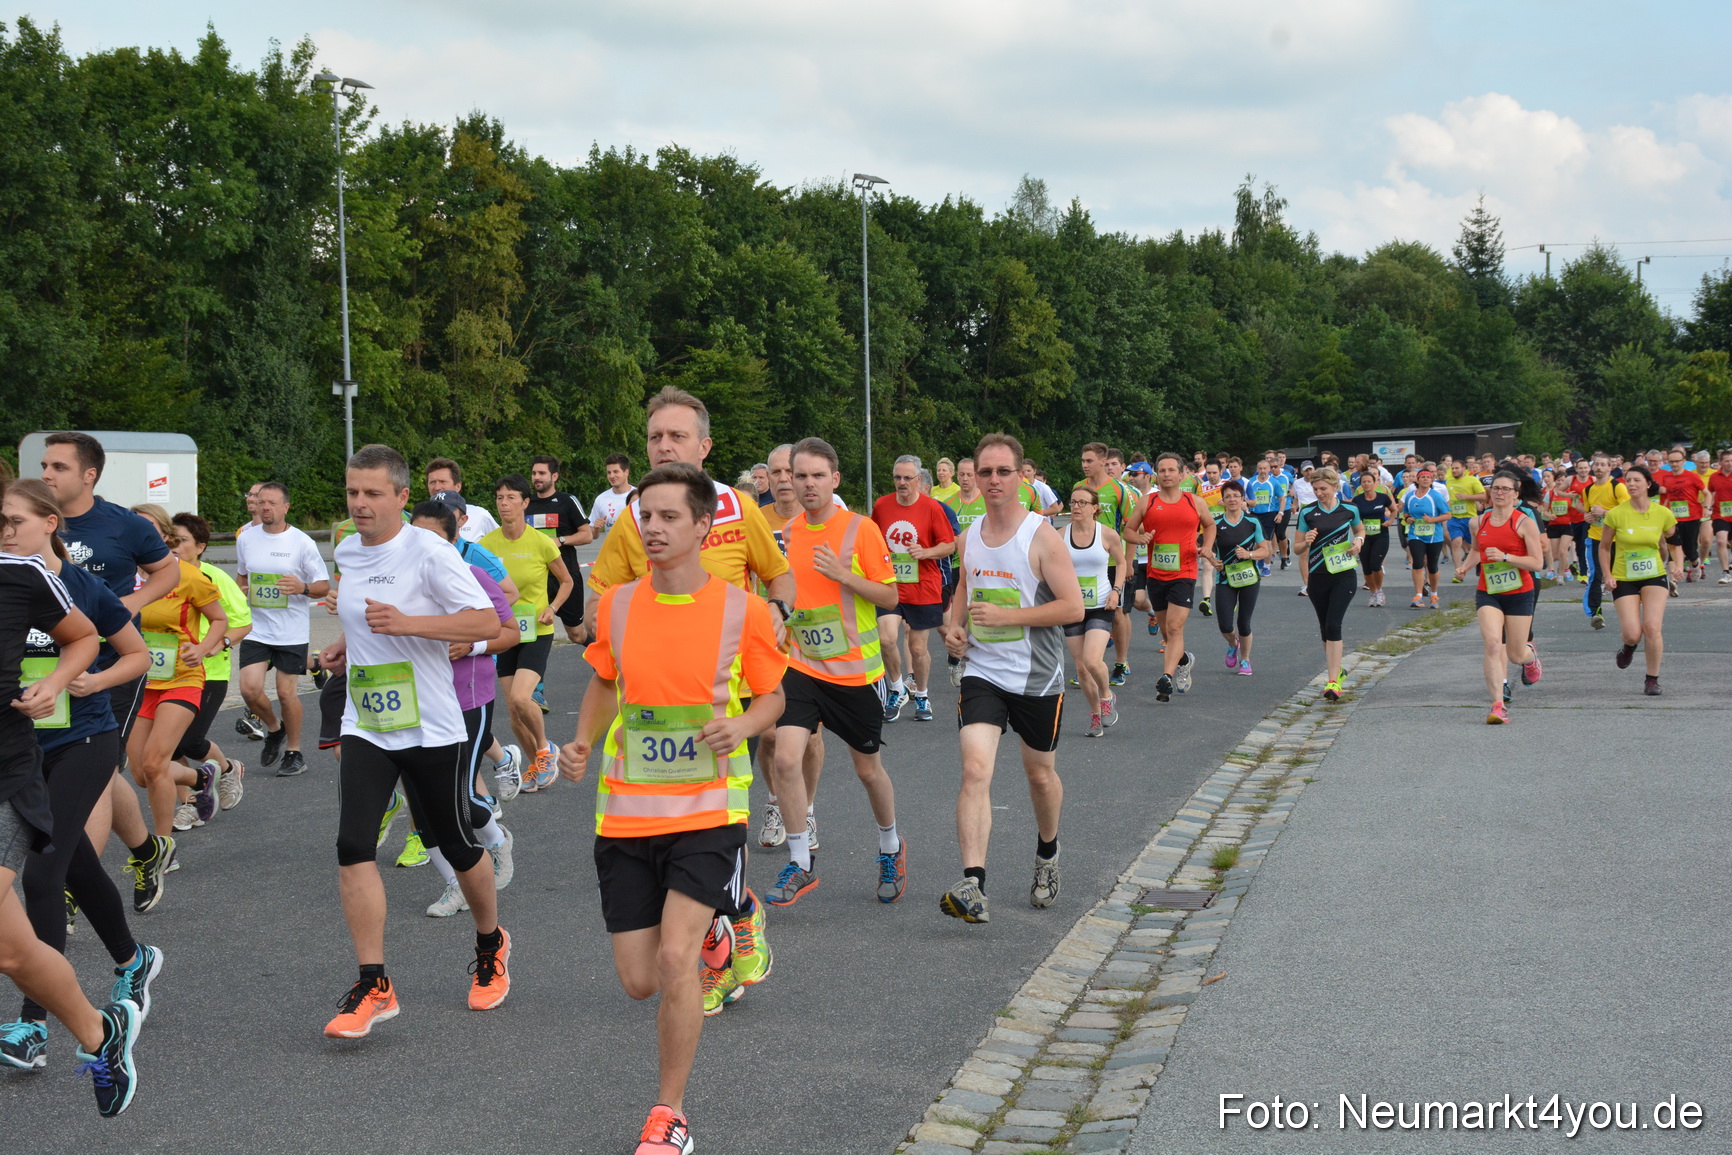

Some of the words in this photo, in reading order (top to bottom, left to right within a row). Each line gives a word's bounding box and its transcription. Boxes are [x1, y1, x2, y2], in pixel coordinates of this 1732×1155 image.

[889, 527, 913, 547] 48
[1153, 553, 1177, 564] 1367
[1328, 552, 1353, 566] 1349
[892, 564, 912, 575] 512
[1632, 560, 1653, 572] 650
[368, 575, 396, 584] FRANZ
[1230, 569, 1254, 582] 1363
[1488, 570, 1517, 585] 1370
[256, 586, 280, 599] 439
[801, 627, 834, 646] 303
[361, 689, 402, 714] 438
[641, 736, 698, 763] 304
